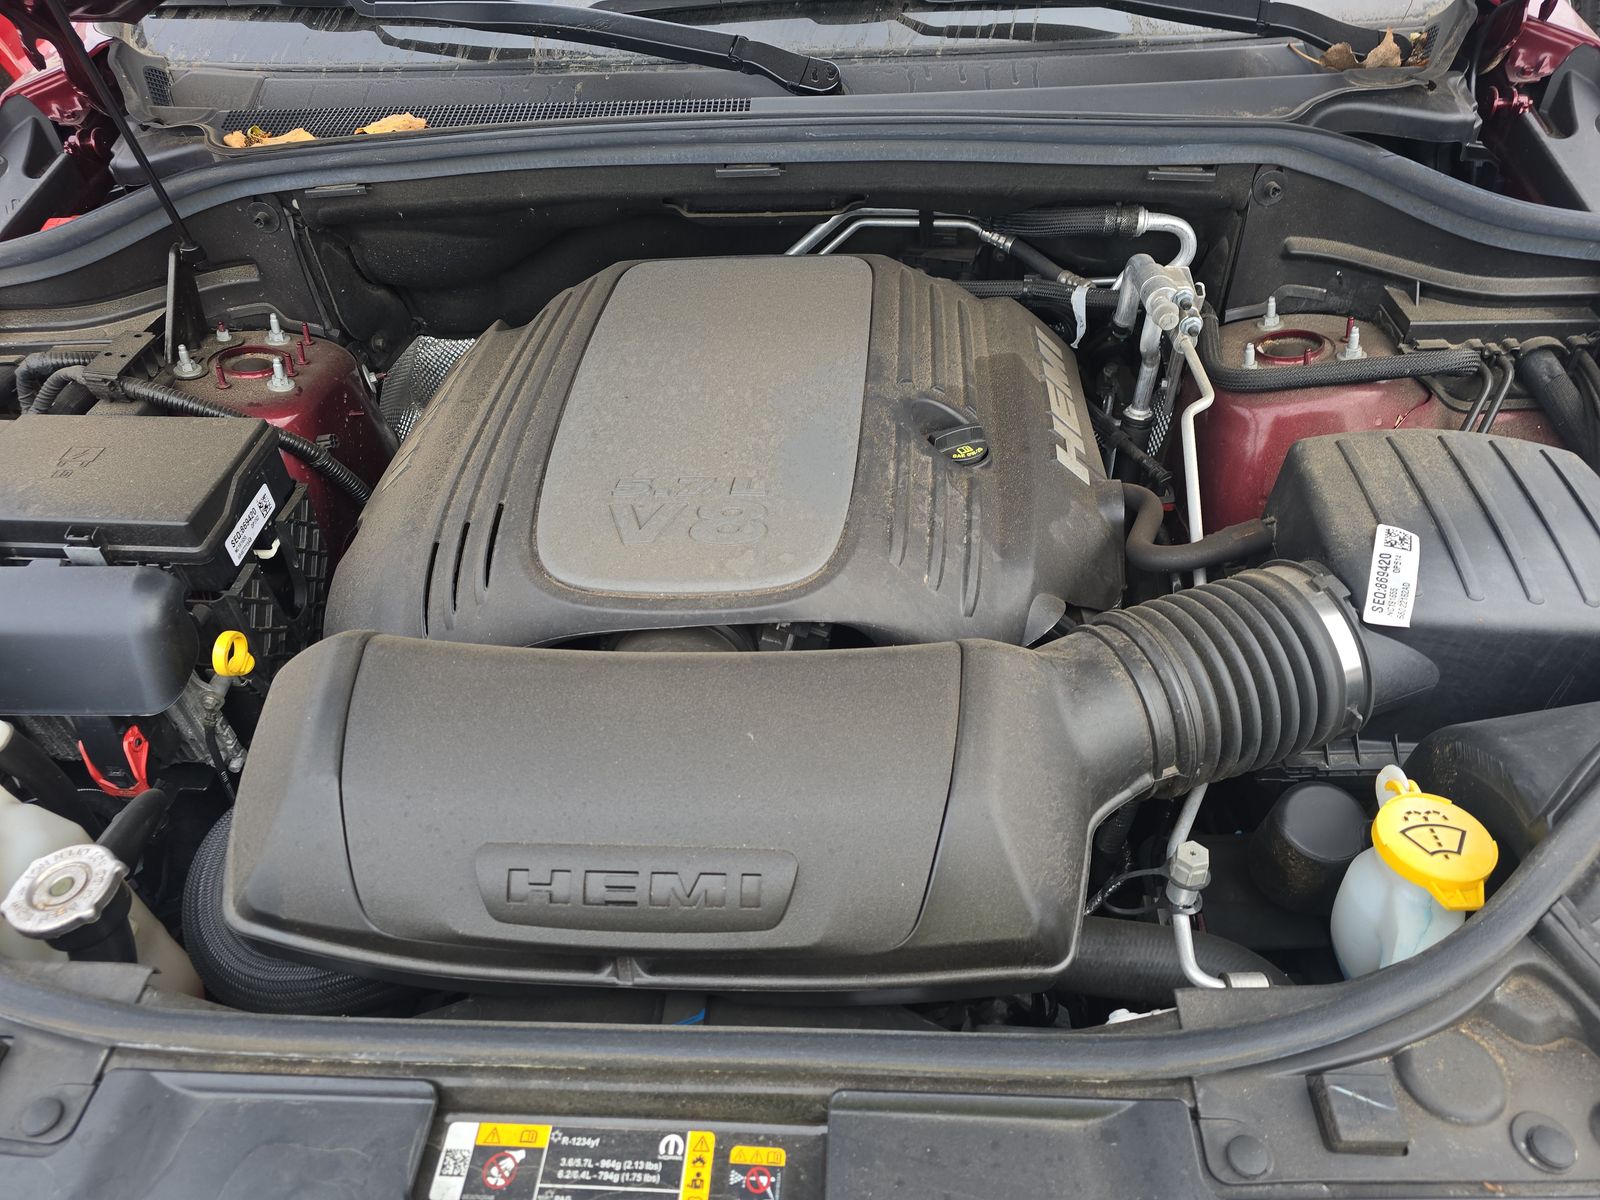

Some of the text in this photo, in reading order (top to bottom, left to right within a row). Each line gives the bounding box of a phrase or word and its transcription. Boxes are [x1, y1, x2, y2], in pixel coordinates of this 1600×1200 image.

[1035, 325, 1090, 486] HEMI
[230, 507, 257, 548] SEQ:869420
[608, 502, 769, 545] V8
[1371, 552, 1392, 613] SEQ:869420
[506, 867, 763, 909] HEMI
[561, 1136, 600, 1148] R-1234yf
[598, 1171, 620, 1183] 794g
[620, 1172, 642, 1183] (1.75
[643, 1173, 661, 1185] lbs)
[600, 1159, 622, 1171] 964g
[623, 1160, 645, 1171] (2.13
[645, 1161, 663, 1172] lbs)
